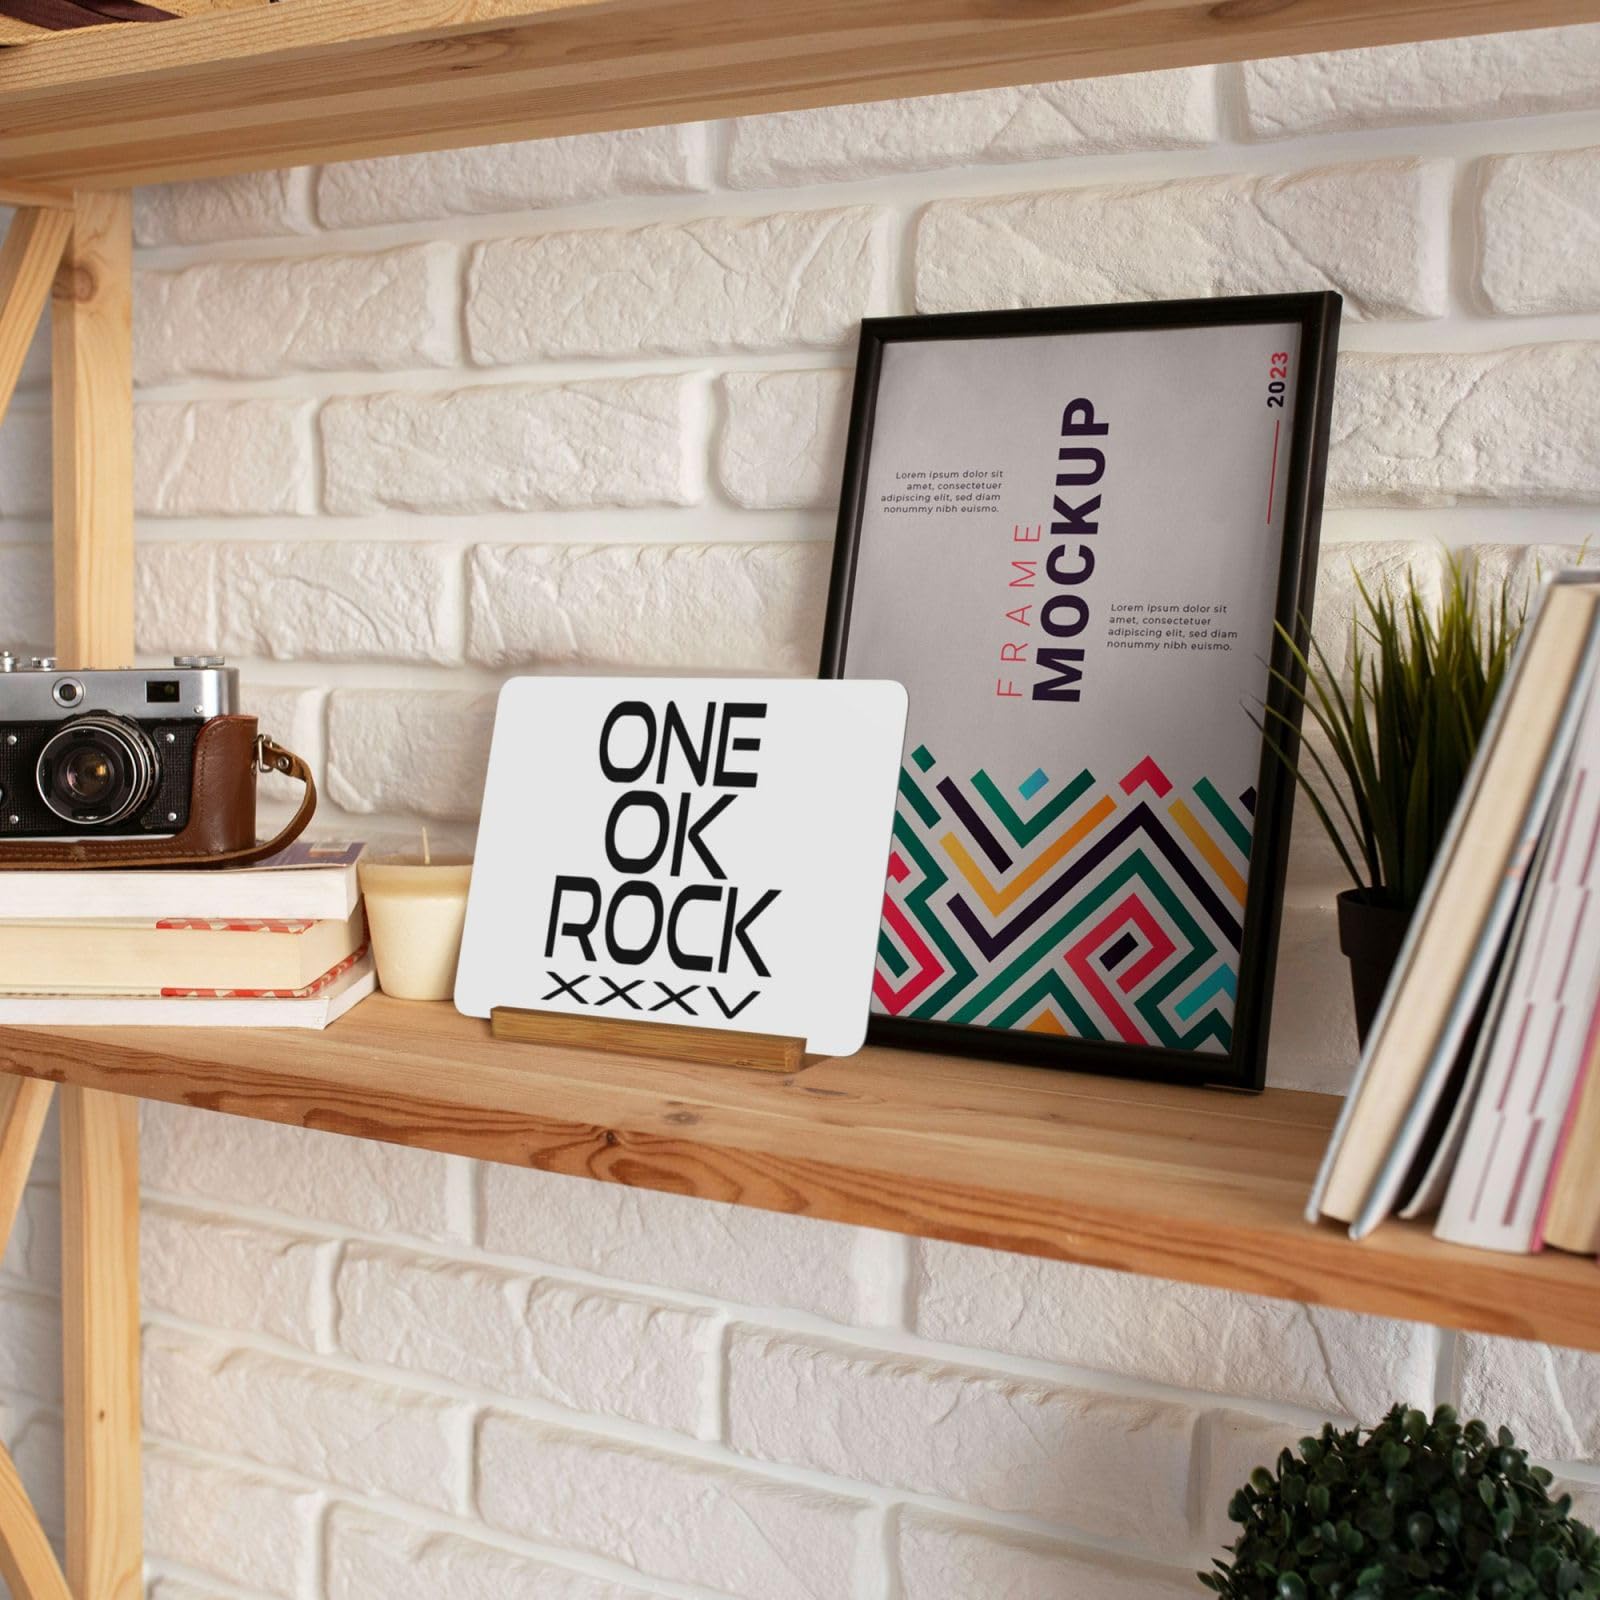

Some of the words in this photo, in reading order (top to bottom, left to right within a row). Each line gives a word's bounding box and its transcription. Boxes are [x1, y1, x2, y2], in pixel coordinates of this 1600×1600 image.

[1267, 351, 1289, 408] 2023
[895, 471, 926, 479] Lorem
[929, 470, 959, 480] ipsum
[962, 470, 988, 478] dolor
[991, 470, 1003, 478] sit
[906, 482, 934, 491] amet,
[937, 481, 1002, 490] consectetuer
[880, 494, 931, 503] adipiscing
[933, 493, 952, 502] elit,
[955, 493, 972, 501] sed
[975, 493, 1001, 501] diam
[883, 505, 933, 514] nonummy
[935, 504, 958, 513] nibh
[960, 504, 999, 512] euismo.
[1032, 397, 1110, 703] MOCKUP
[996, 524, 1042, 699] FRAME
[1111, 604, 1143, 612] Lorem
[1147, 604, 1179, 613] ipsum
[1183, 604, 1210, 613] dolor
[1213, 605, 1227, 613] sit
[1109, 616, 1138, 625] amet,
[1142, 617, 1211, 625] consectetuer
[1108, 628, 1162, 638] adipiscing
[1165, 628, 1185, 638] elit,
[1188, 629, 1207, 638] sed
[1210, 629, 1238, 639] diam
[1106, 640, 1160, 651] nonummy
[1163, 641, 1187, 650] nibh
[1191, 642, 1232, 651] euismo.
[599, 701, 767, 787] ONE
[604, 791, 738, 880] OK
[544, 875, 782, 978] ROCK
[541, 971, 761, 1020] XXXV
